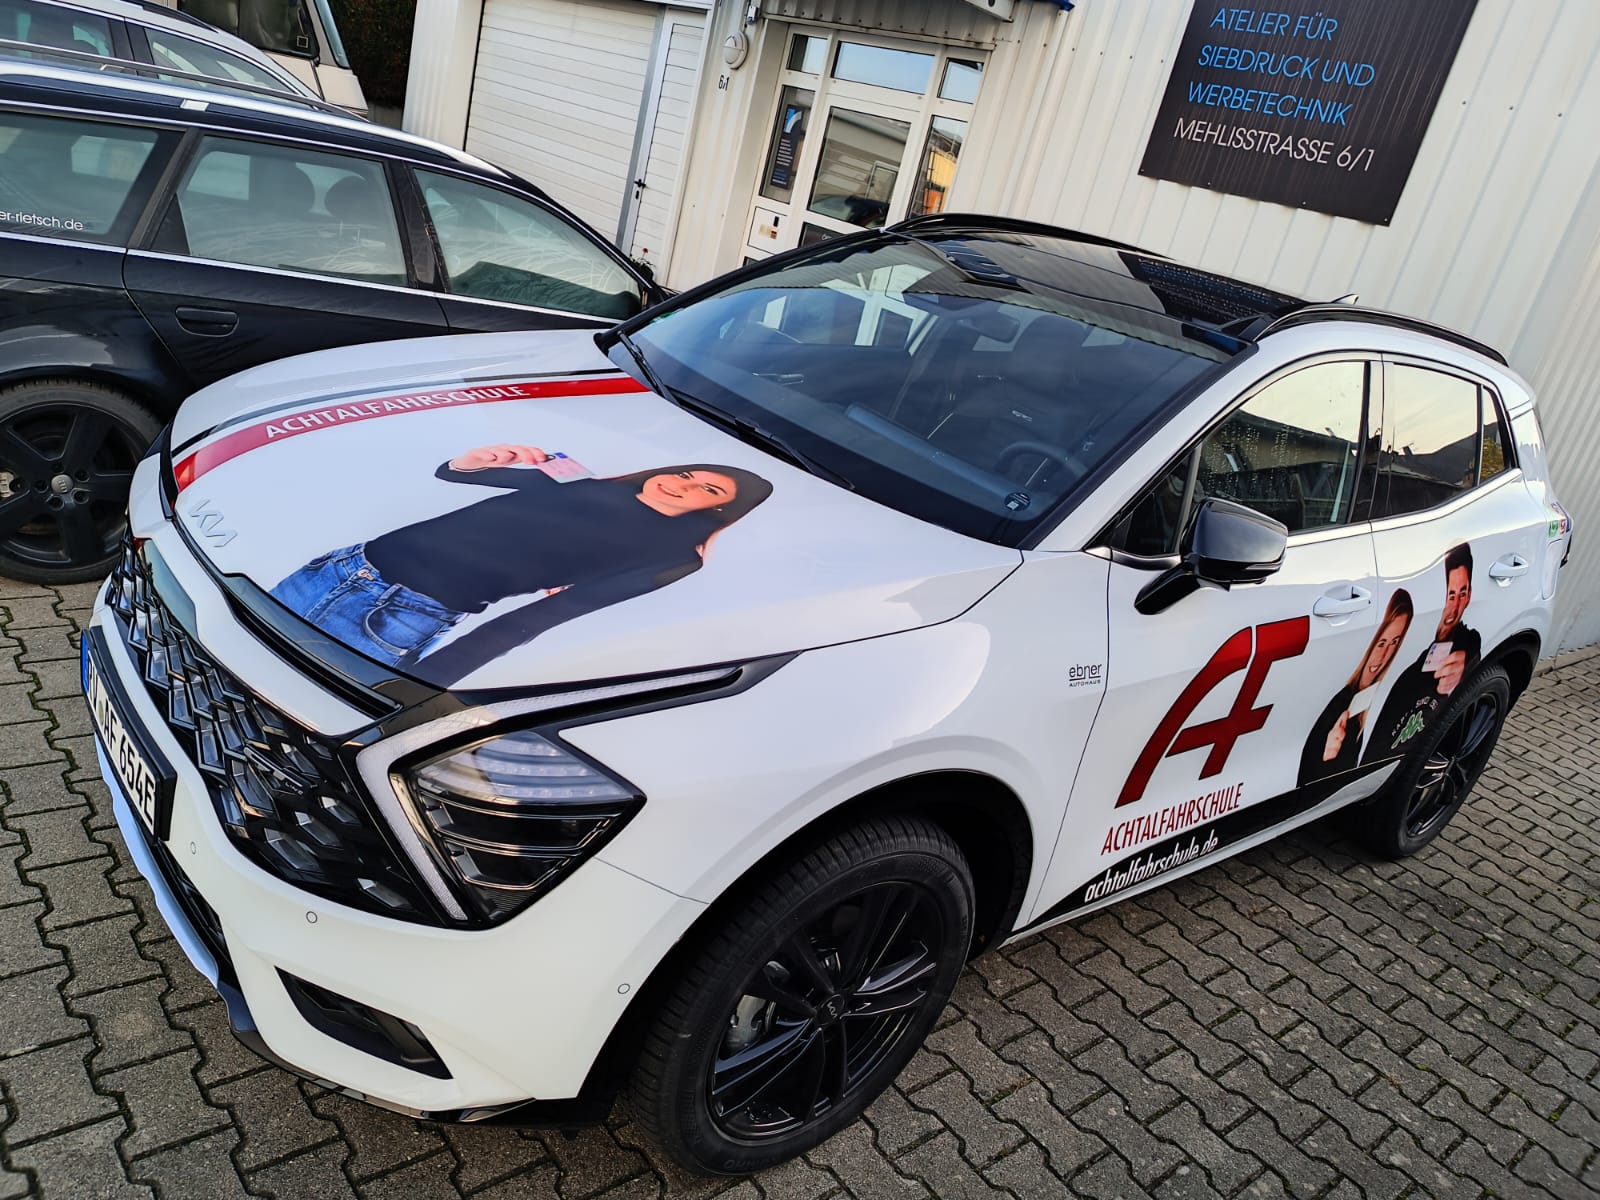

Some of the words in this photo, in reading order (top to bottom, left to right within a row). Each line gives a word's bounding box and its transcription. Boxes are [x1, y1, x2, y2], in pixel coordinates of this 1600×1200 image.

[1209, 7, 1290, 37] ATELIER
[1293, 11, 1338, 41] FÜR
[1198, 44, 1319, 80] SIEBDRUCK
[1321, 59, 1376, 87] UND
[1188, 81, 1353, 126] WERBETECHNIK
[1173, 117, 1335, 164] MEHLISSTRASSE
[1336, 145, 1375, 171] 6/1
[265, 385, 531, 439] ACHTALFAHRSCHULE
[1069, 663, 1102, 680] ebner
[103, 699, 117, 751] AF
[119, 733, 155, 826] 654E
[1100, 782, 1244, 856] ACHTALFAHRSCHULE
[1084, 829, 1219, 903] achtalfahrschule.de
